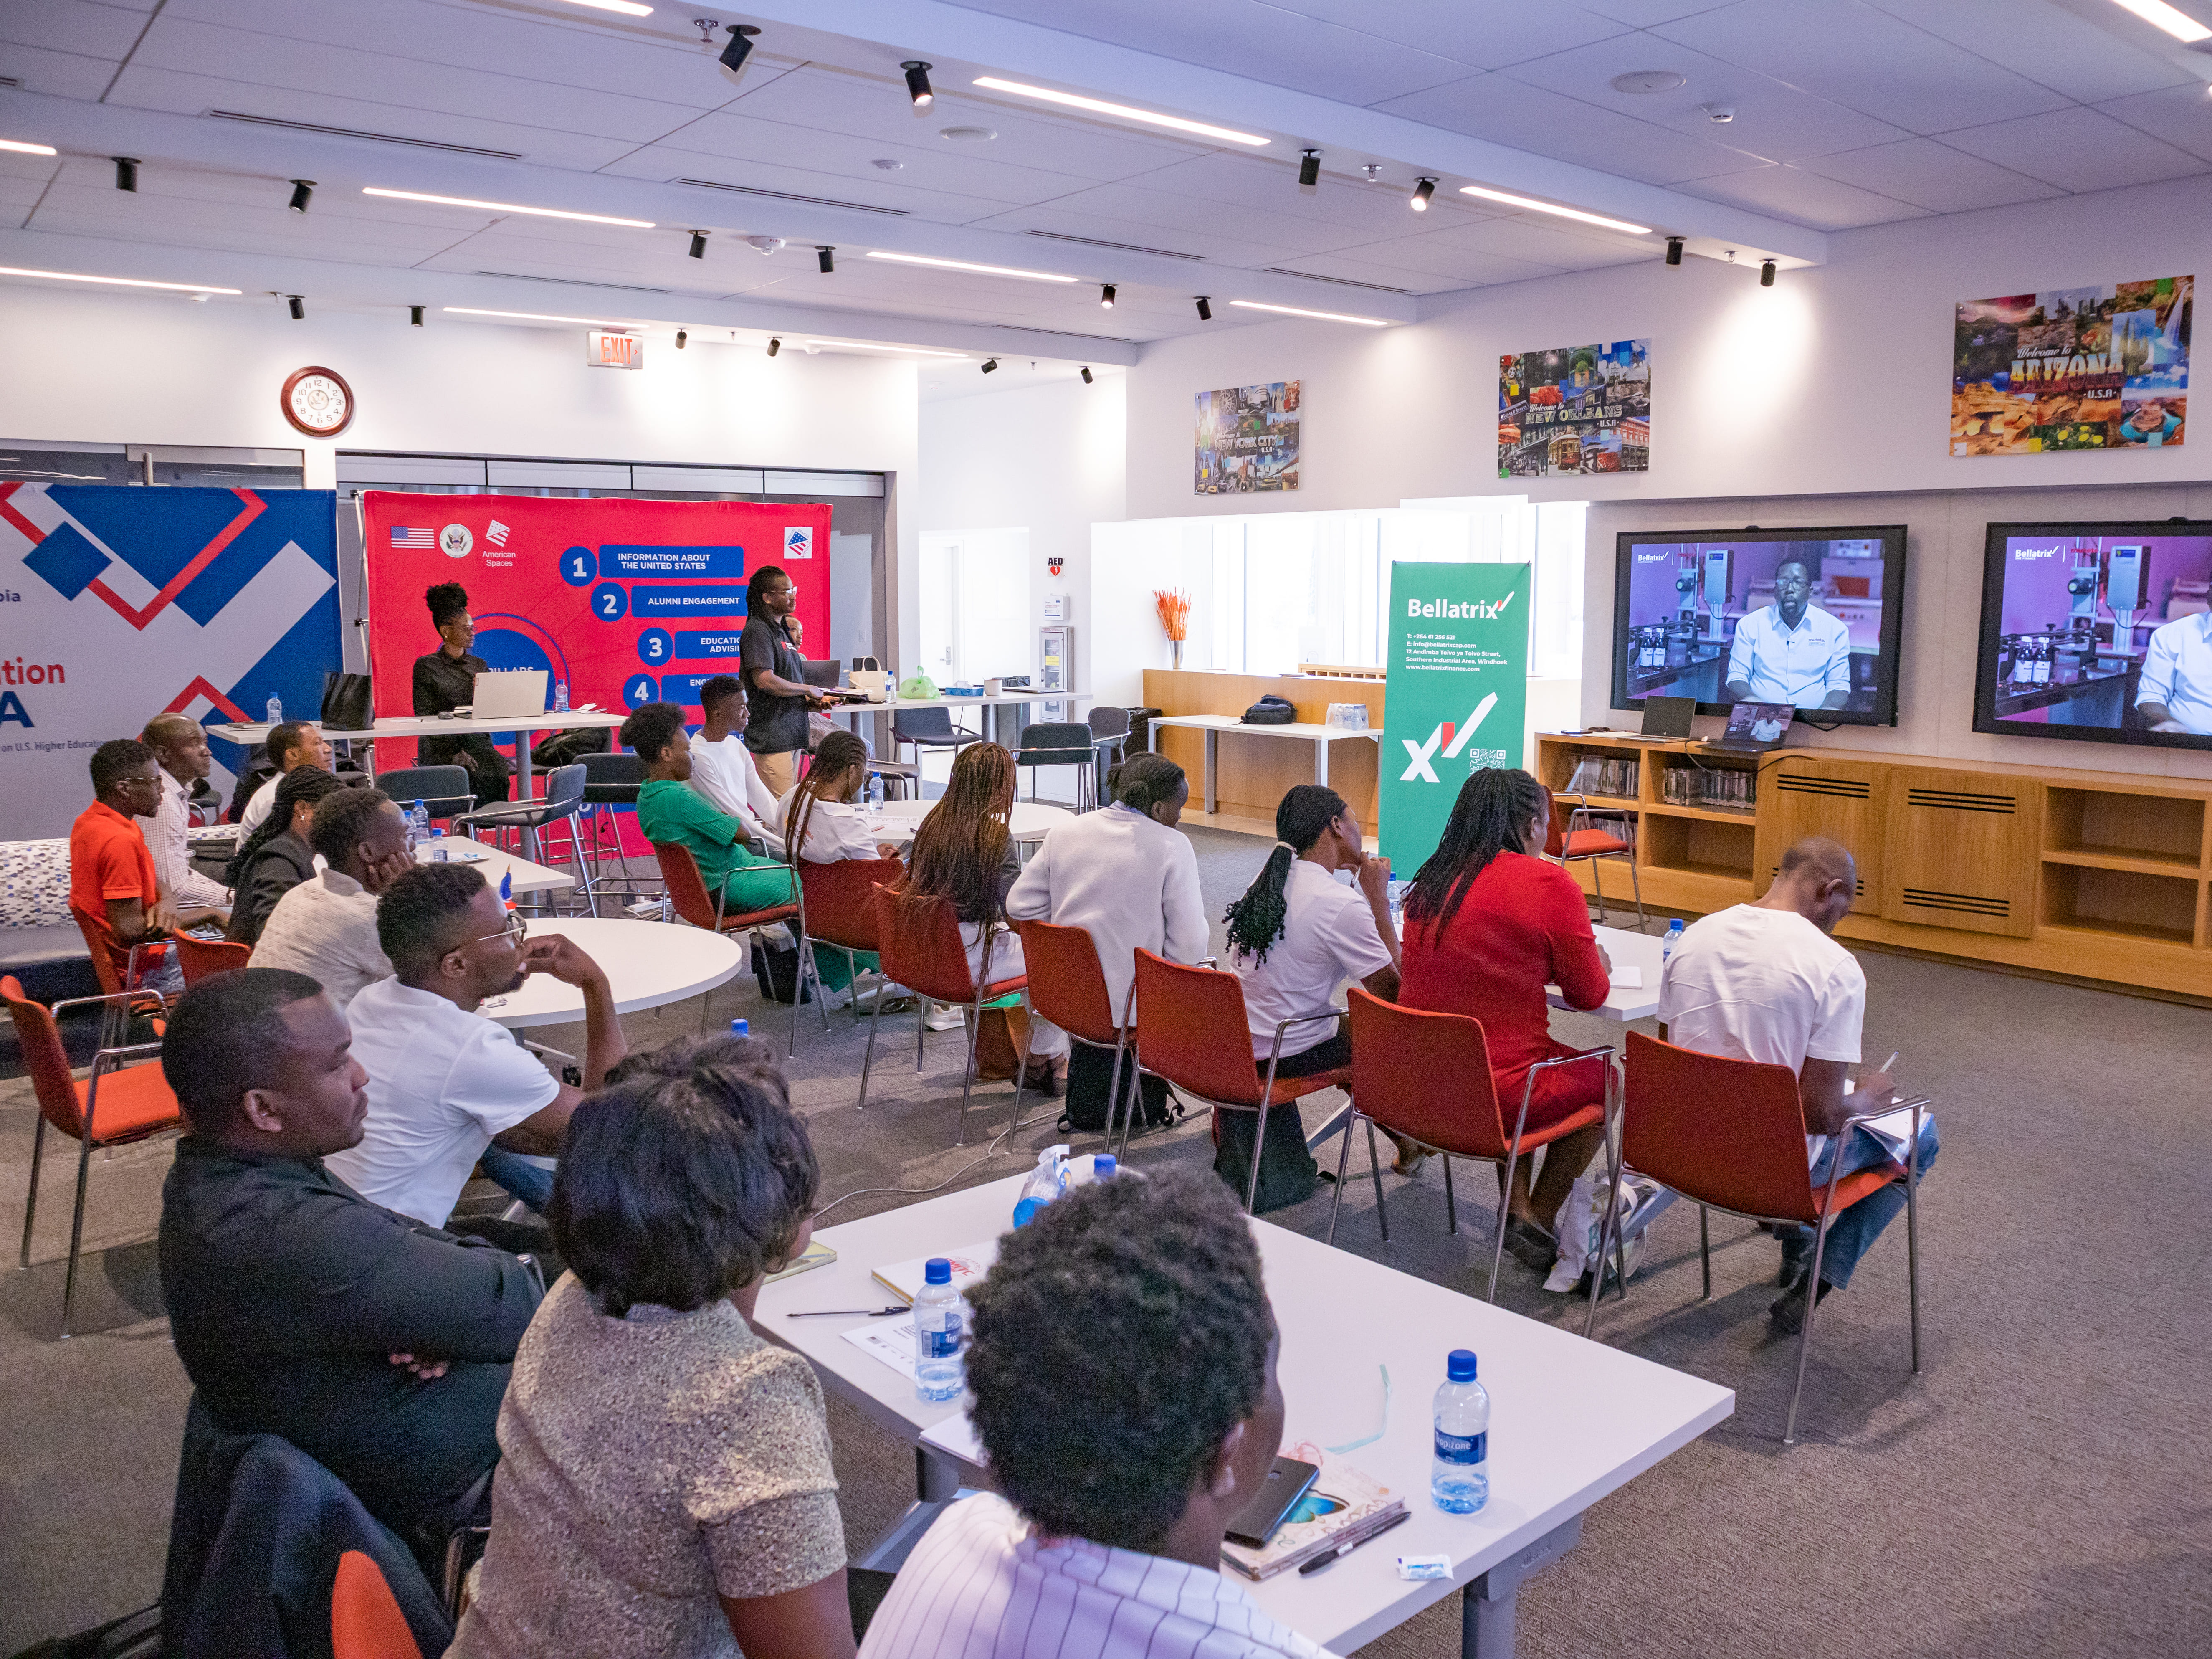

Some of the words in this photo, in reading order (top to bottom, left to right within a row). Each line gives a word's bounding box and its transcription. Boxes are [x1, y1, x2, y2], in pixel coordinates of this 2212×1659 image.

[601, 336, 632, 364] EXIT
[2017, 346, 2059, 358] Welcome
[2062, 345, 2071, 355] to
[1526, 411, 1556, 424] NEW
[1559, 405, 1622, 420] ORLEANS
[1529, 404, 1556, 412] Welcome
[1215, 438, 1233, 450] NEW
[1234, 436, 1257, 449] YORK
[1258, 435, 1278, 446] CITY
[2015, 549, 2053, 557] Bellatrix
[573, 557, 587, 577] 1
[603, 594, 617, 614] 2
[1408, 598, 1502, 619] Bellatrix
[649, 638, 663, 657] 3
[0, 656, 65, 685] tion
[635, 682, 649, 701] 4
[35, 742, 65, 752] Higher
[68, 739, 104, 749] Educatio
